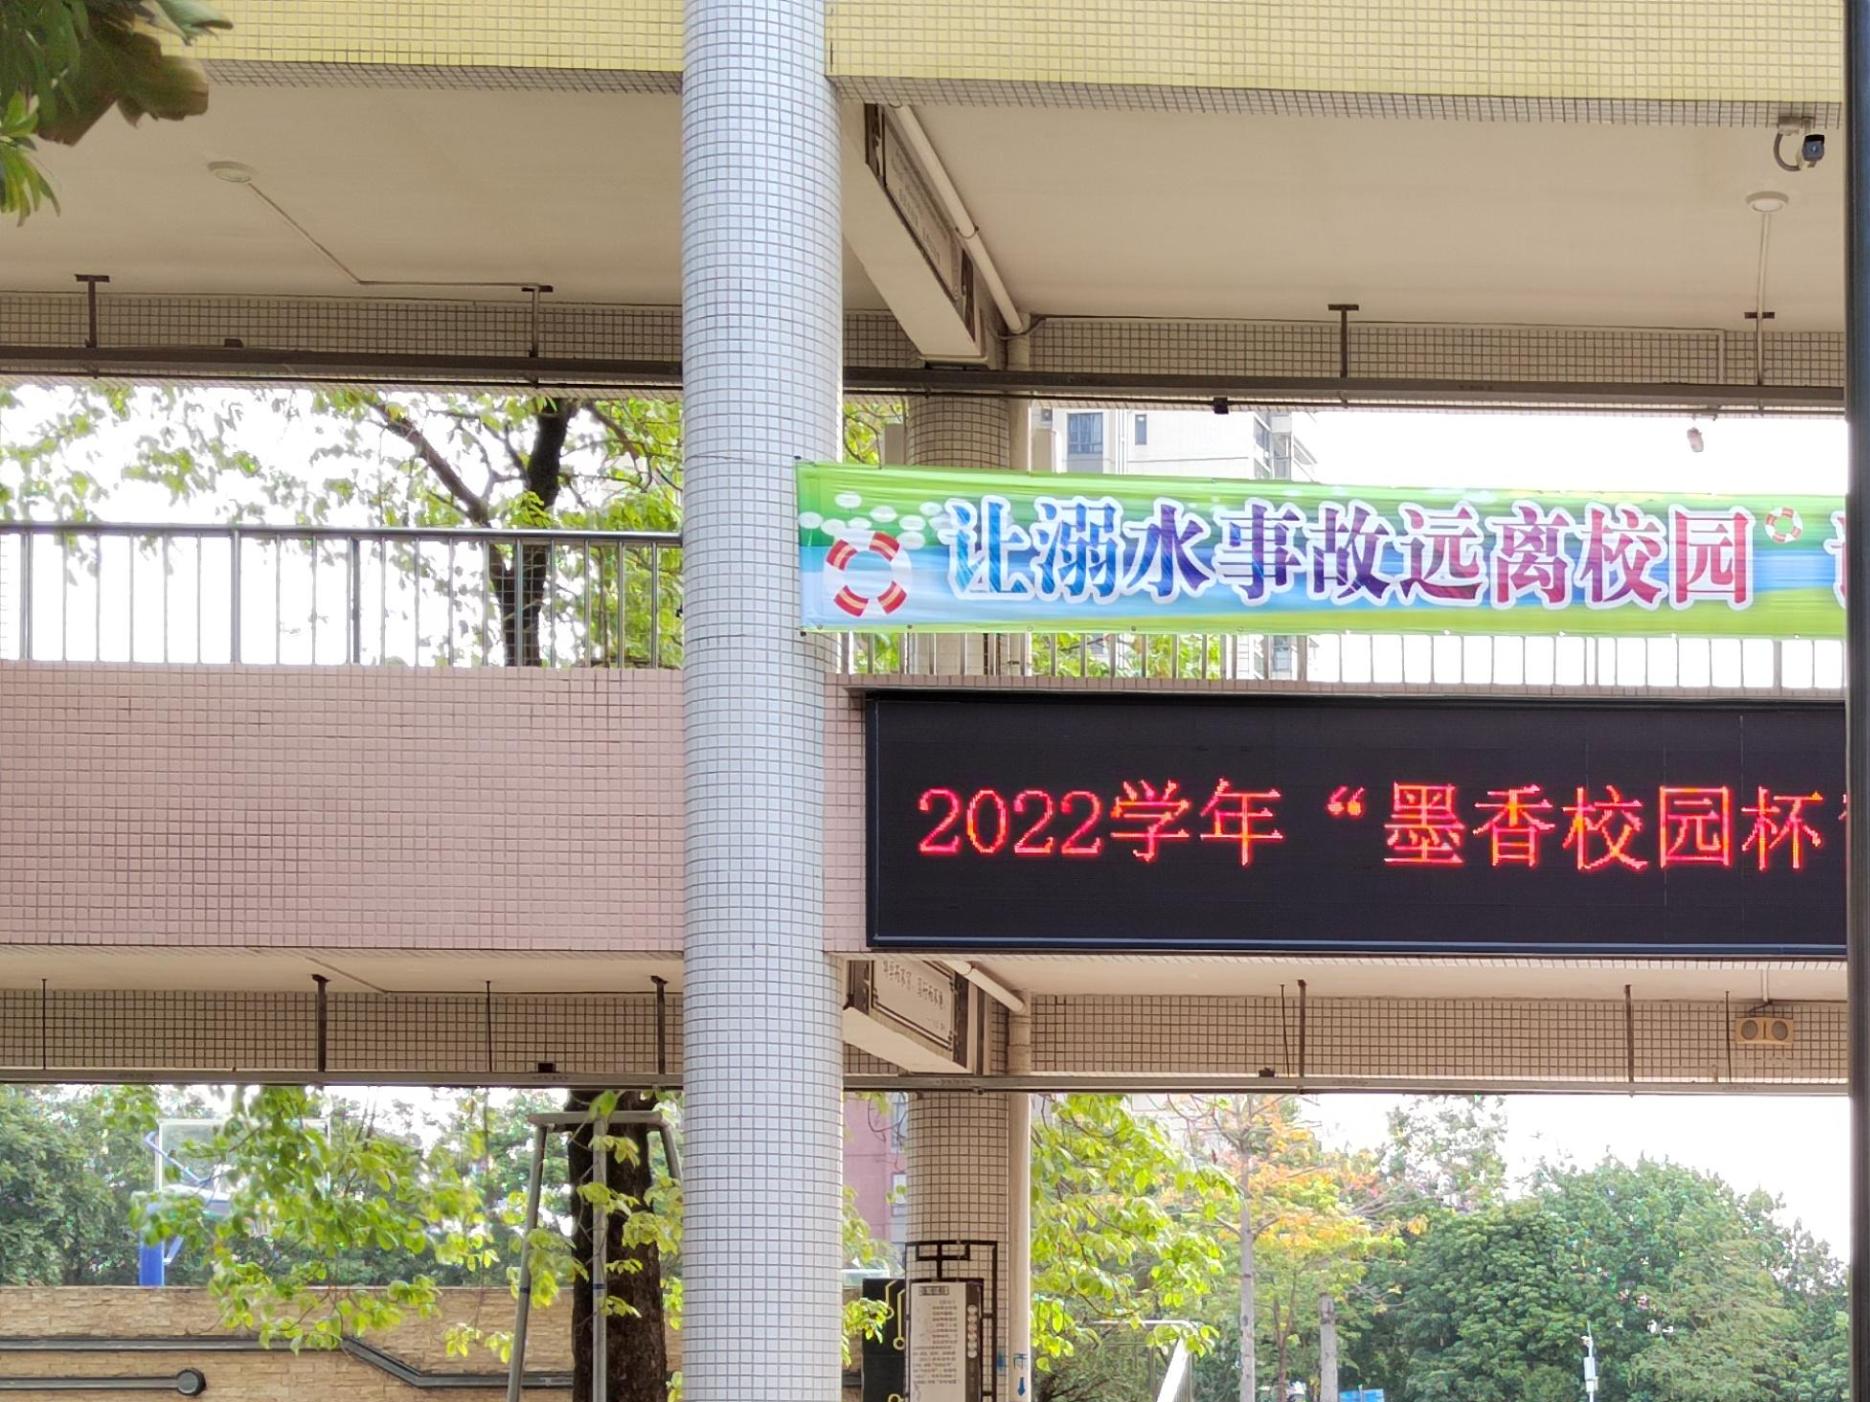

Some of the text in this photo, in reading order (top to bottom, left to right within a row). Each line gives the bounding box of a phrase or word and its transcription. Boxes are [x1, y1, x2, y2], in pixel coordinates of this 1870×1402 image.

[942, 497, 1756, 606] 让溺水事故远离校园
